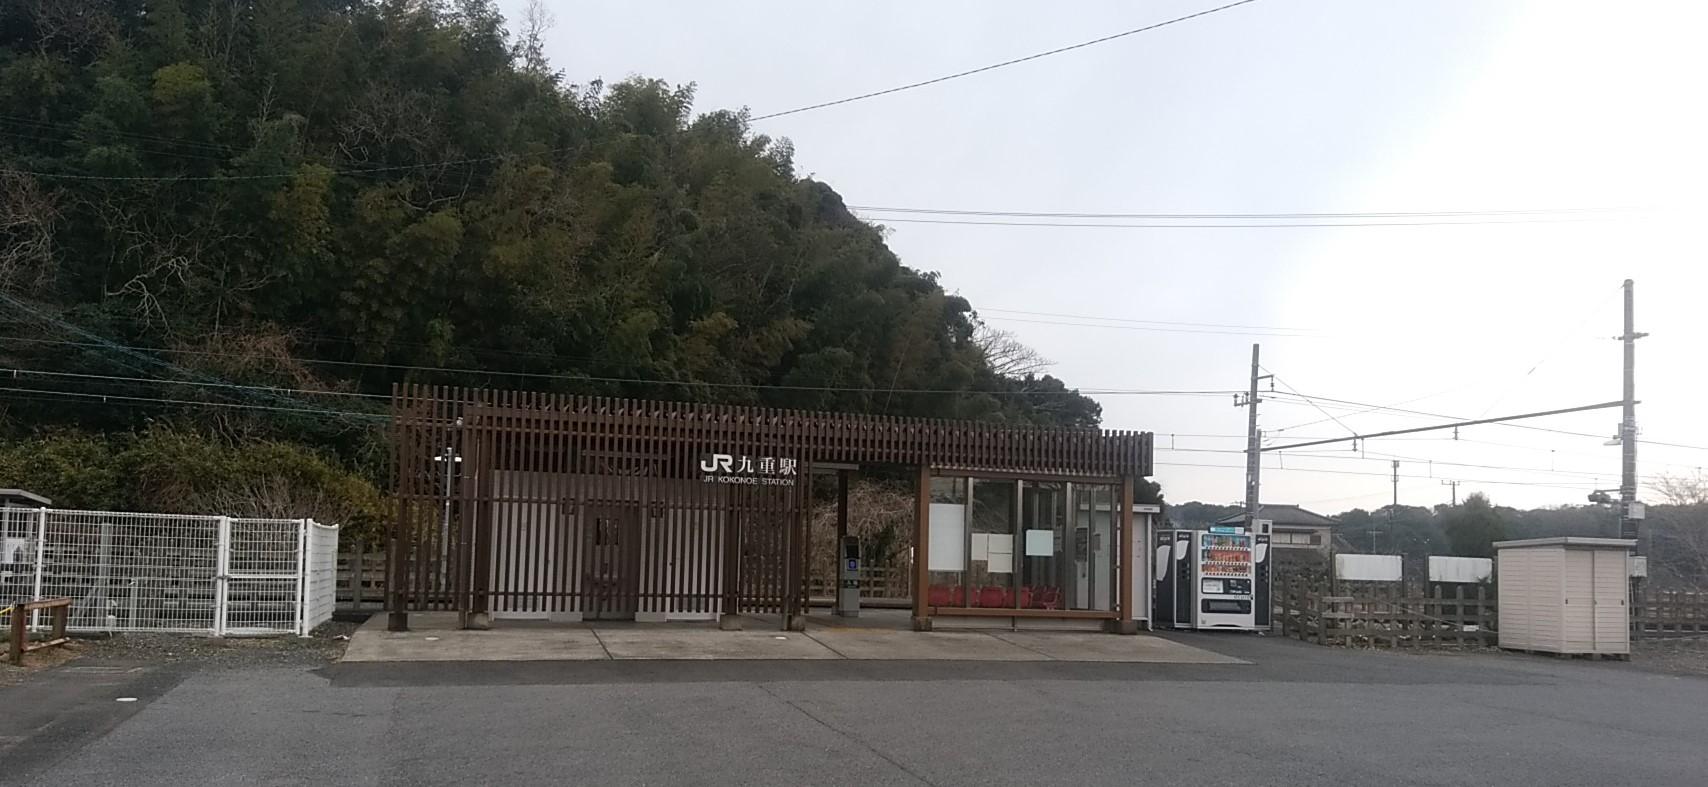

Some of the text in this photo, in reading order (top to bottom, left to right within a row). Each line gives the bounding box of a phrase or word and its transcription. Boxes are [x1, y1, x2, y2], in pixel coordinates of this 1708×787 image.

[701, 454, 797, 475] JR 九重駅
[718, 476, 758, 485] KOKONOE
[762, 478, 794, 486] STATION
